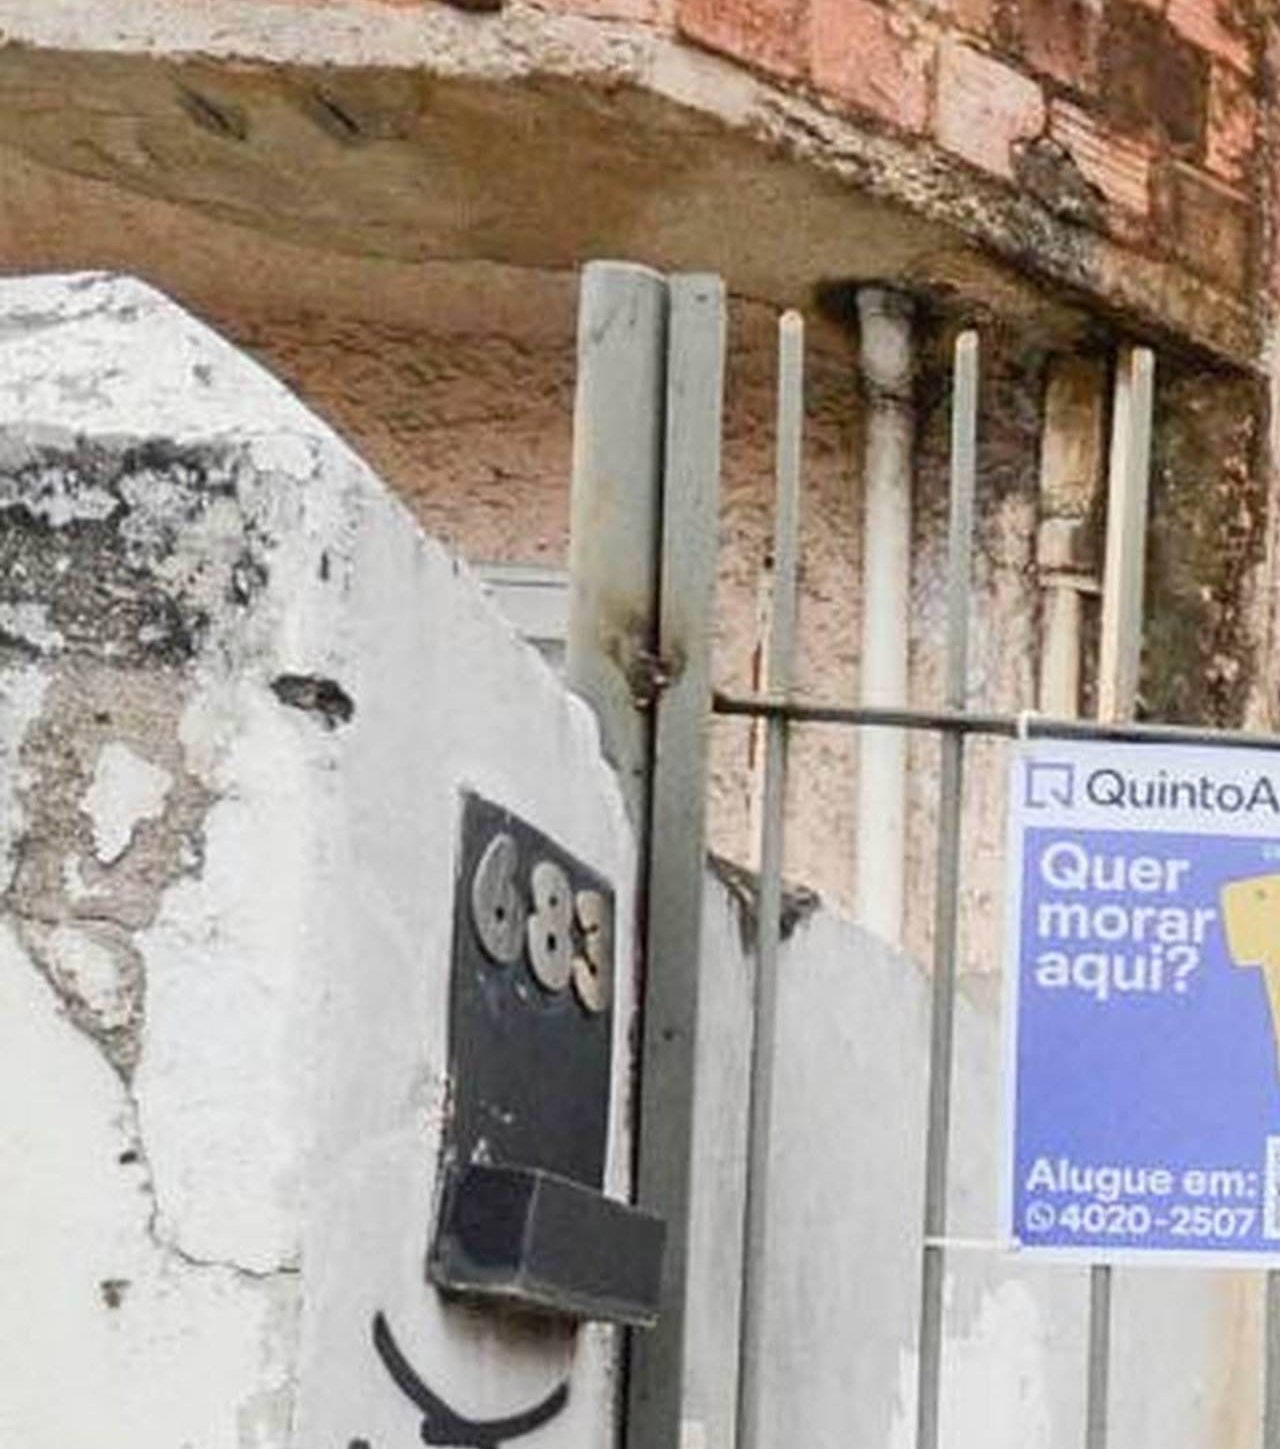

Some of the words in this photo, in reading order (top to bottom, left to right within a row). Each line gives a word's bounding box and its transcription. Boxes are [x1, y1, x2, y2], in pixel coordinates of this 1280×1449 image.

[1041, 843, 1190, 893] Quer
[472, 832, 605, 1013] 683
[1037, 900, 1216, 943] morar
[1033, 946, 1200, 1000] aqui?
[1026, 1158, 1173, 1202] Alugue
[1183, 1169, 1258, 1198] em:
[1058, 1202, 1255, 1238] 4020-2507
